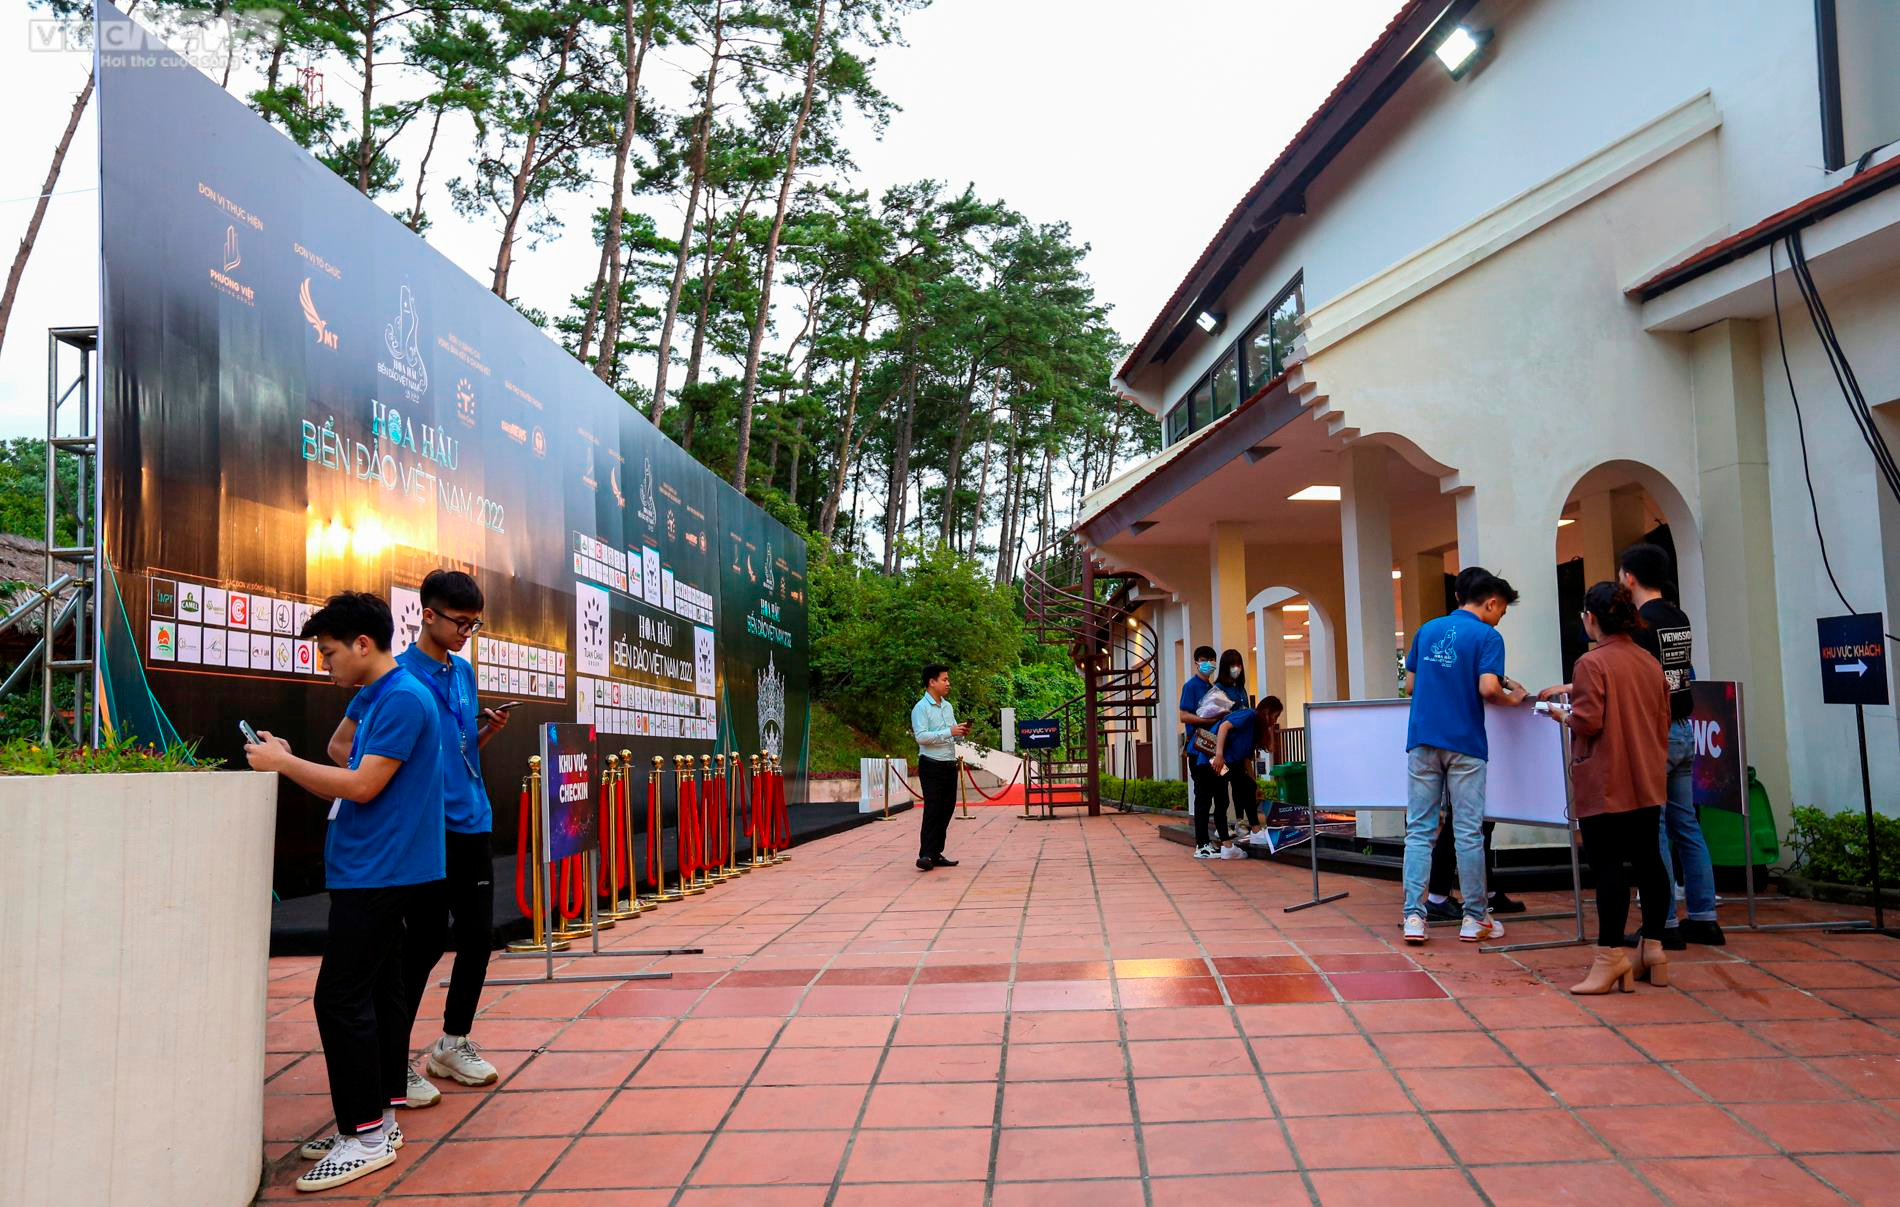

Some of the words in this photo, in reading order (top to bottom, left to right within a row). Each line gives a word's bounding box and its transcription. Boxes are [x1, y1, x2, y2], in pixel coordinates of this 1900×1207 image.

[209, 268, 240, 293] PHƯƠNG
[240, 282, 256, 301] VIỆT
[370, 399, 417, 453] HOA
[421, 423, 459, 471] HẬU
[302, 414, 351, 475] BIỂN
[355, 437, 398, 491] ĐẢO
[399, 461, 437, 506] VIỆT
[438, 478, 473, 523] NAM
[476, 495, 505, 535] 2022
[181, 600, 199, 611] CAMEL
[638, 614, 656, 643] HOA
[657, 618, 673, 648] HẬU
[613, 632, 632, 670] BIỂN
[632, 640, 649, 672] ĐẢO
[648, 648, 664, 680] VIỆT
[664, 656, 679, 680] NAM
[679, 659, 693, 682] 2022
[1822, 646, 1836, 660] KHU
[1836, 644, 1853, 661] VỰC
[1853, 640, 1882, 658] KHÁCH
[1687, 718, 1722, 759] WC
[558, 755, 574, 774] KHU
[574, 752, 588, 777] VỰC
[559, 782, 588, 804] CHECKIN
